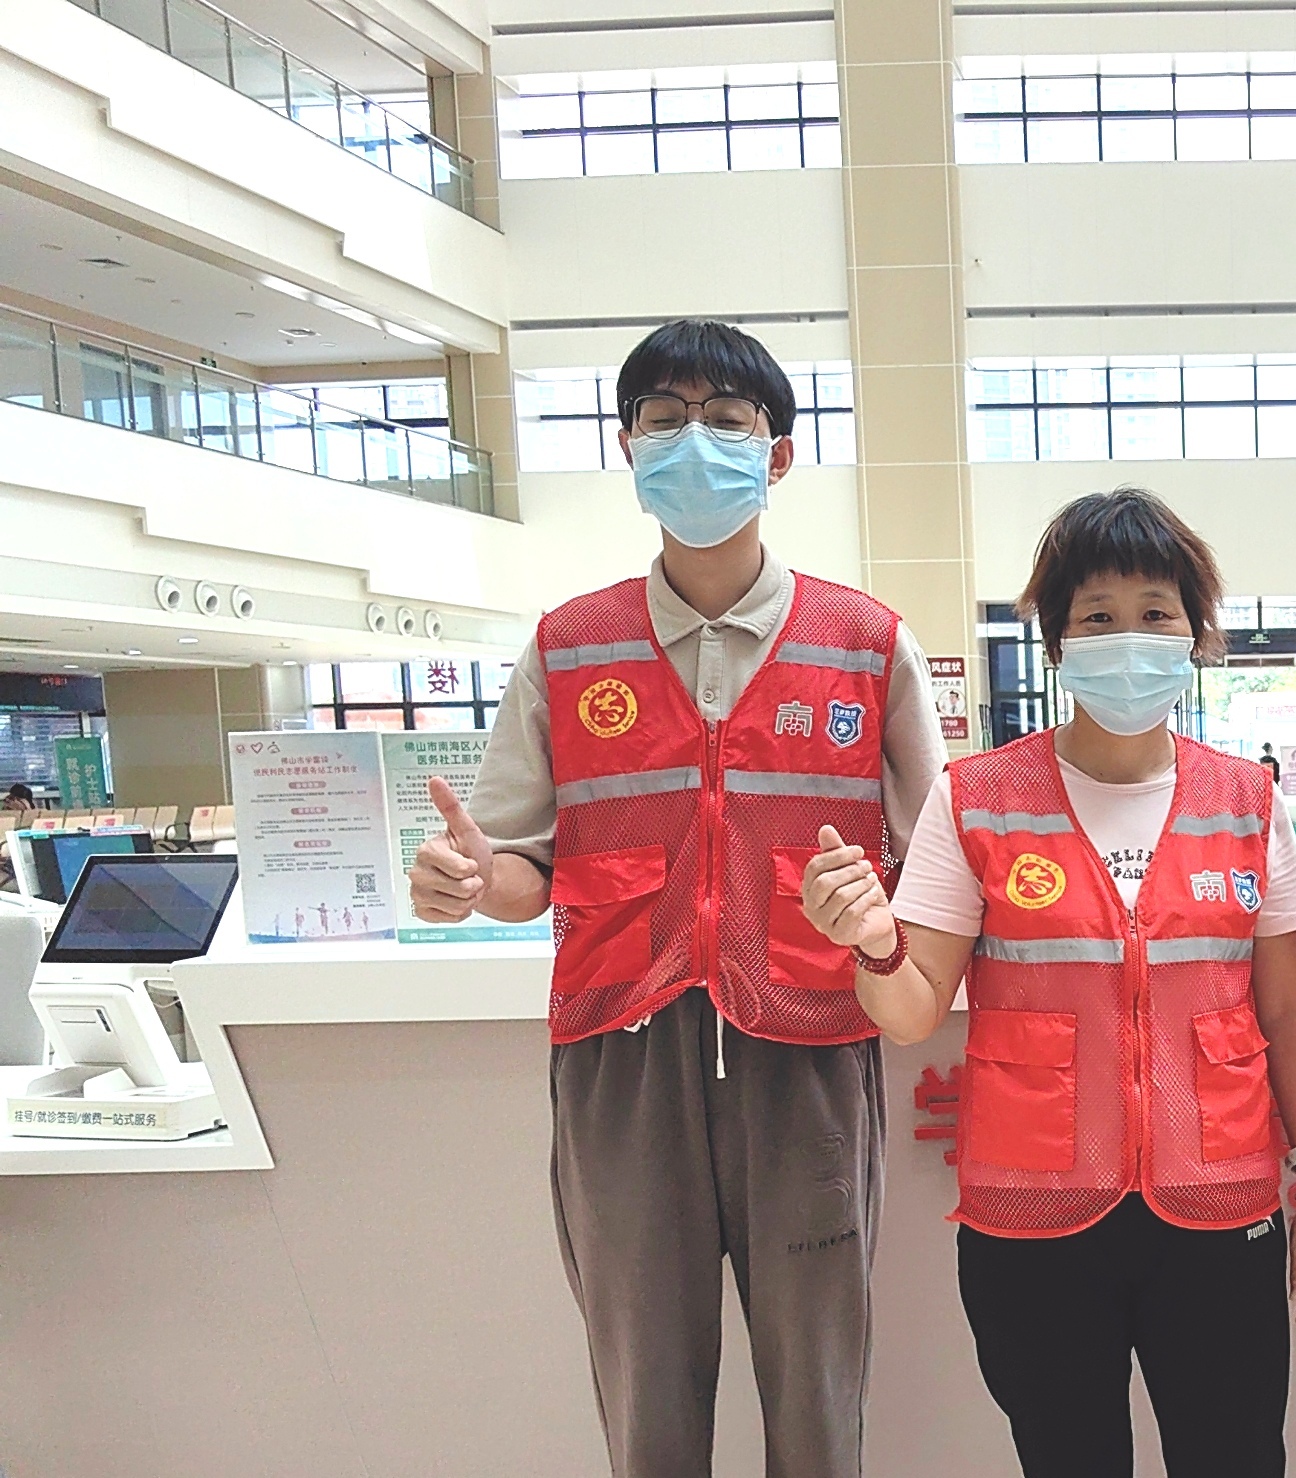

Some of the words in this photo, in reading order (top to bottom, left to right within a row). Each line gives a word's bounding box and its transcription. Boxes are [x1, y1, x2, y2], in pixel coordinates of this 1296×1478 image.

[13, 1109, 158, 1128] 挂号/就诊签到/缴费一站式服务
